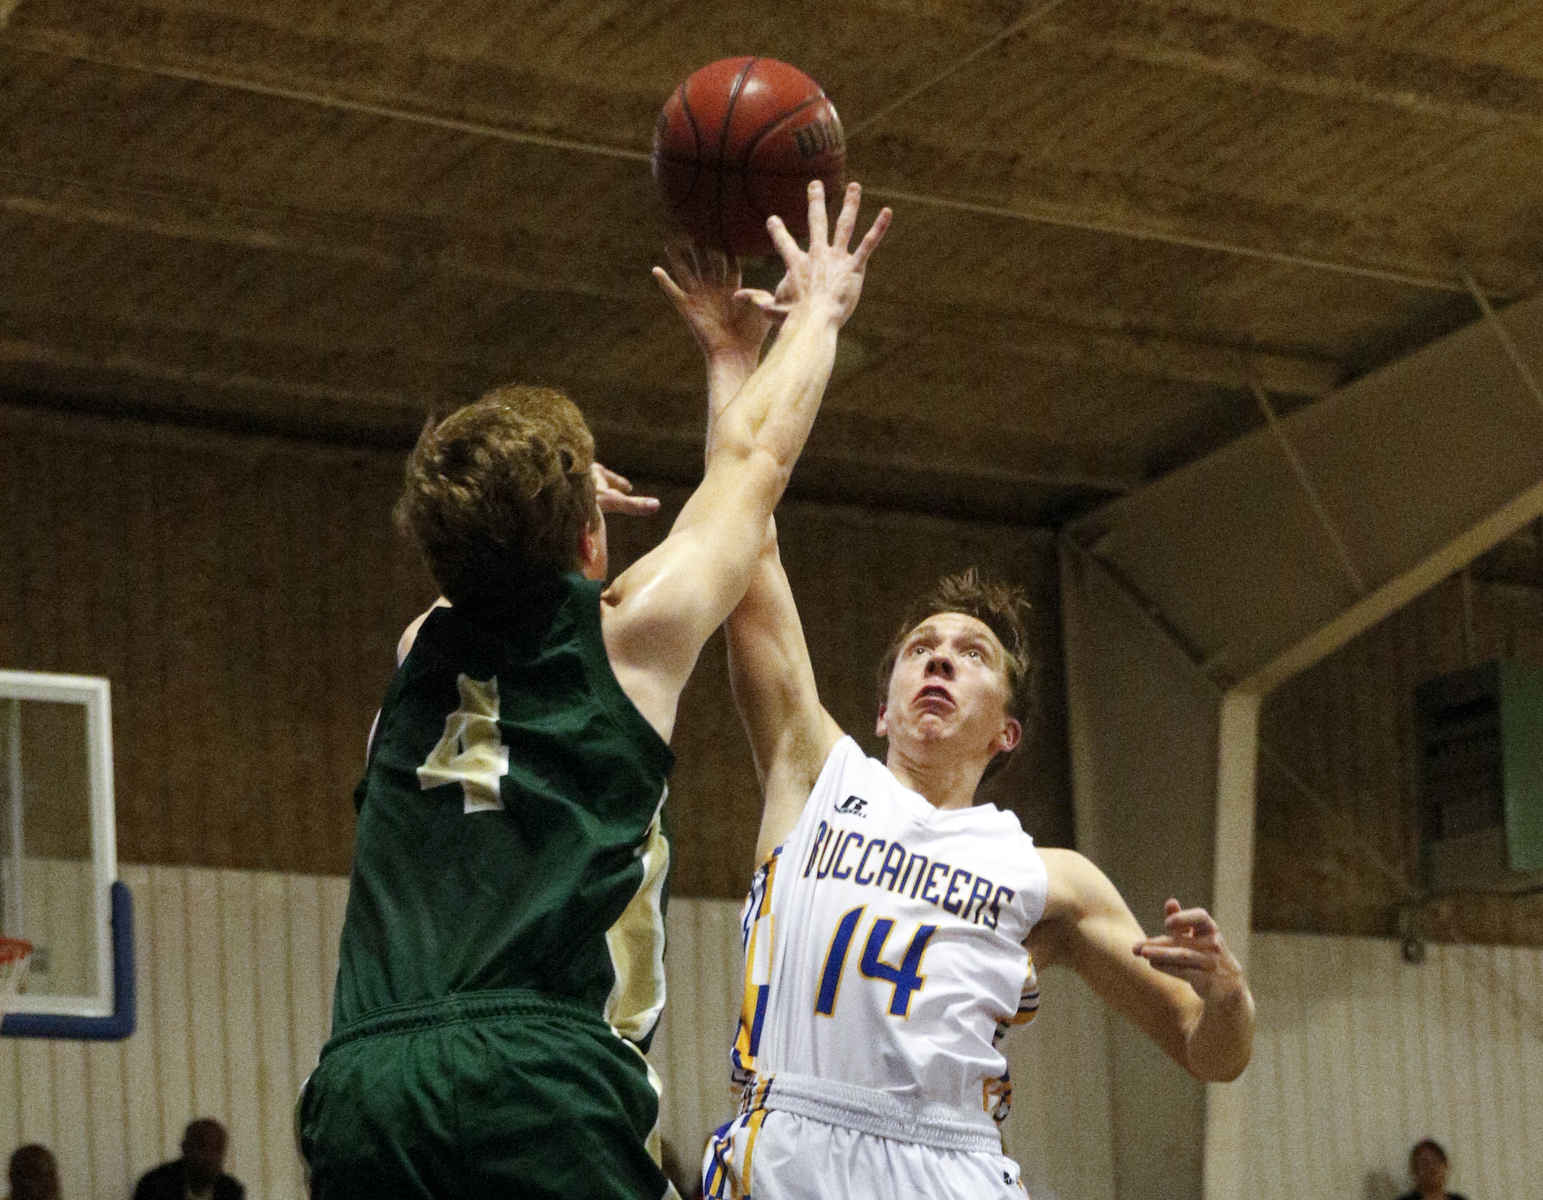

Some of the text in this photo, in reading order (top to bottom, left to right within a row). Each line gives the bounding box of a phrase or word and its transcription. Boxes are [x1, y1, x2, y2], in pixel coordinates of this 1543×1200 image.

[416, 672, 510, 814] 4
[803, 820, 1016, 931] BUCCANEERS
[814, 903, 941, 1020] 14
